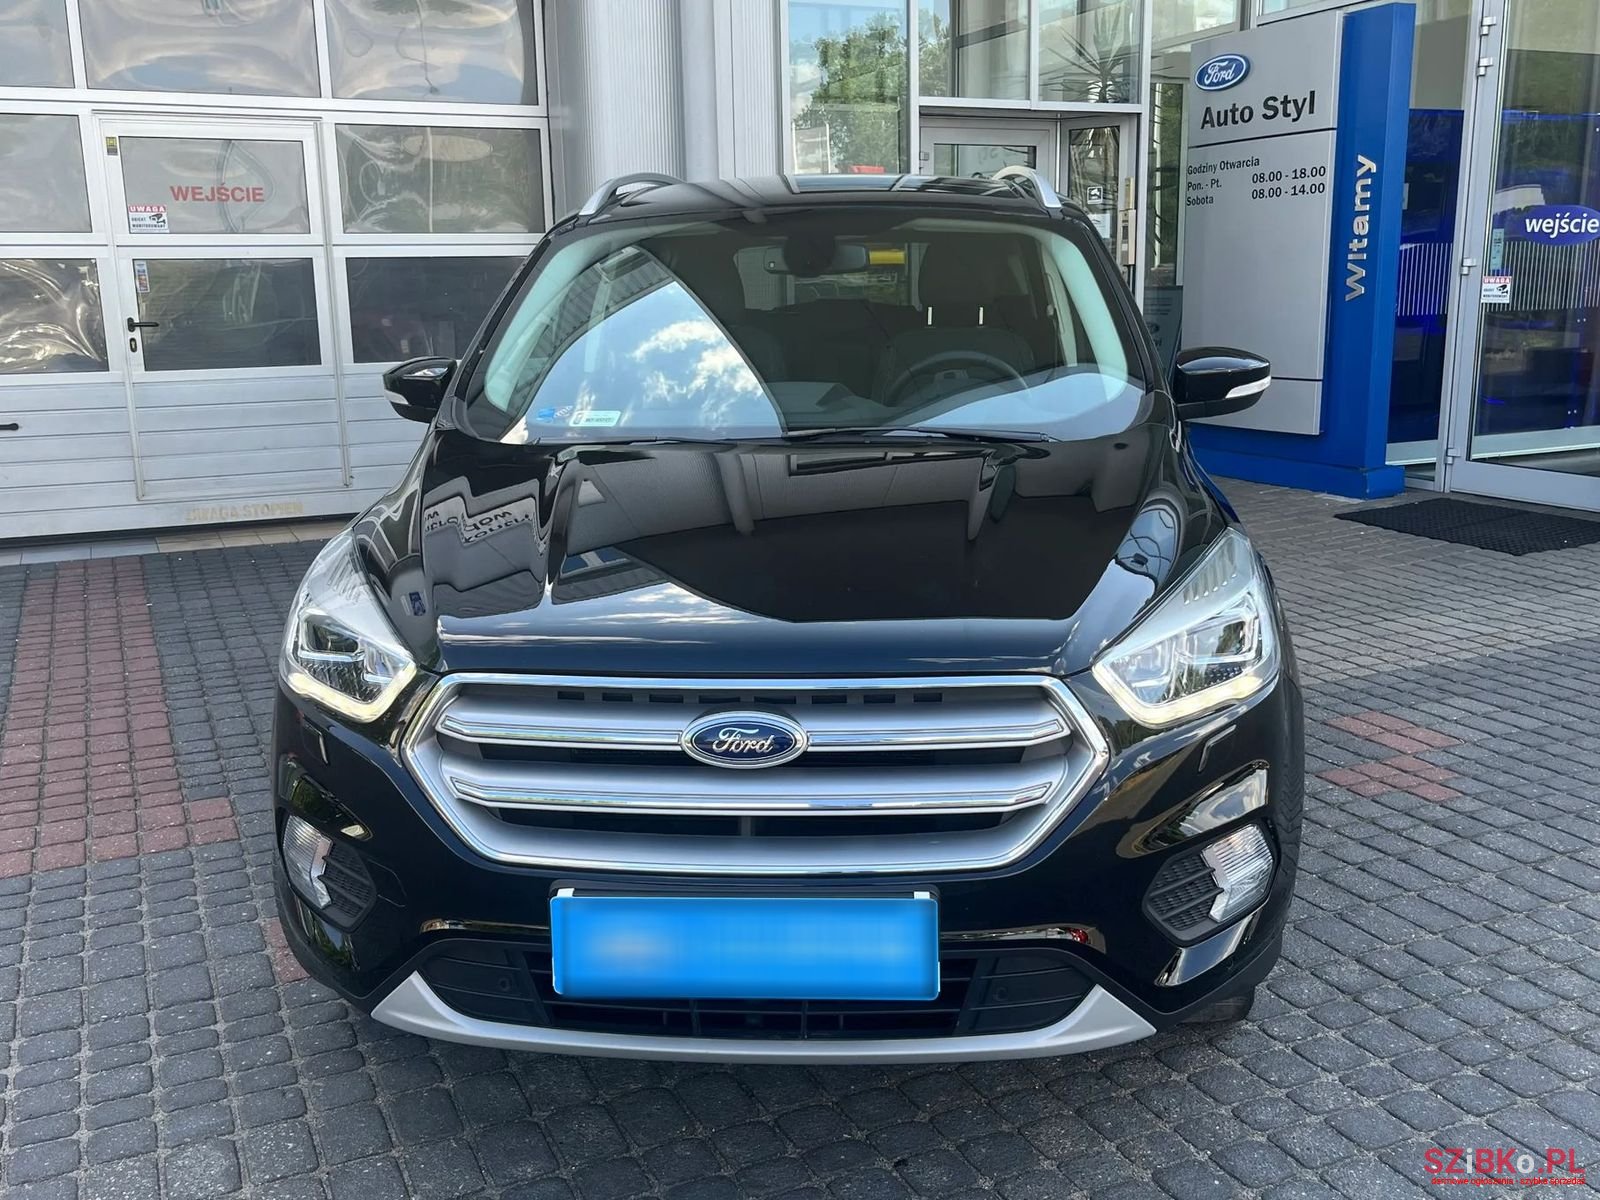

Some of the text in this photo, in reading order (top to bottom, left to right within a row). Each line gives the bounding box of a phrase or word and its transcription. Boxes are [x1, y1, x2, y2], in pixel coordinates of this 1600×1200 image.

[1204, 60, 1236, 85] Ford
[1200, 90, 1316, 130] Auto Styl
[1187, 156, 1260, 176] Godziny Otwarcia
[1187, 181, 1204, 191] Pon.
[1210, 178, 1222, 189] Pt.
[1252, 171, 1282, 184] 08.00
[1291, 166, 1326, 180] 18.00
[169, 182, 265, 202] WEJŚCIE
[1186, 195, 1214, 206] Sobota
[1251, 187, 1282, 199] 08.00
[1290, 183, 1325, 196] 14.00
[1345, 154, 1377, 301] Witamy
[1525, 212, 1600, 239] wejście
[712, 727, 774, 754] Ford
